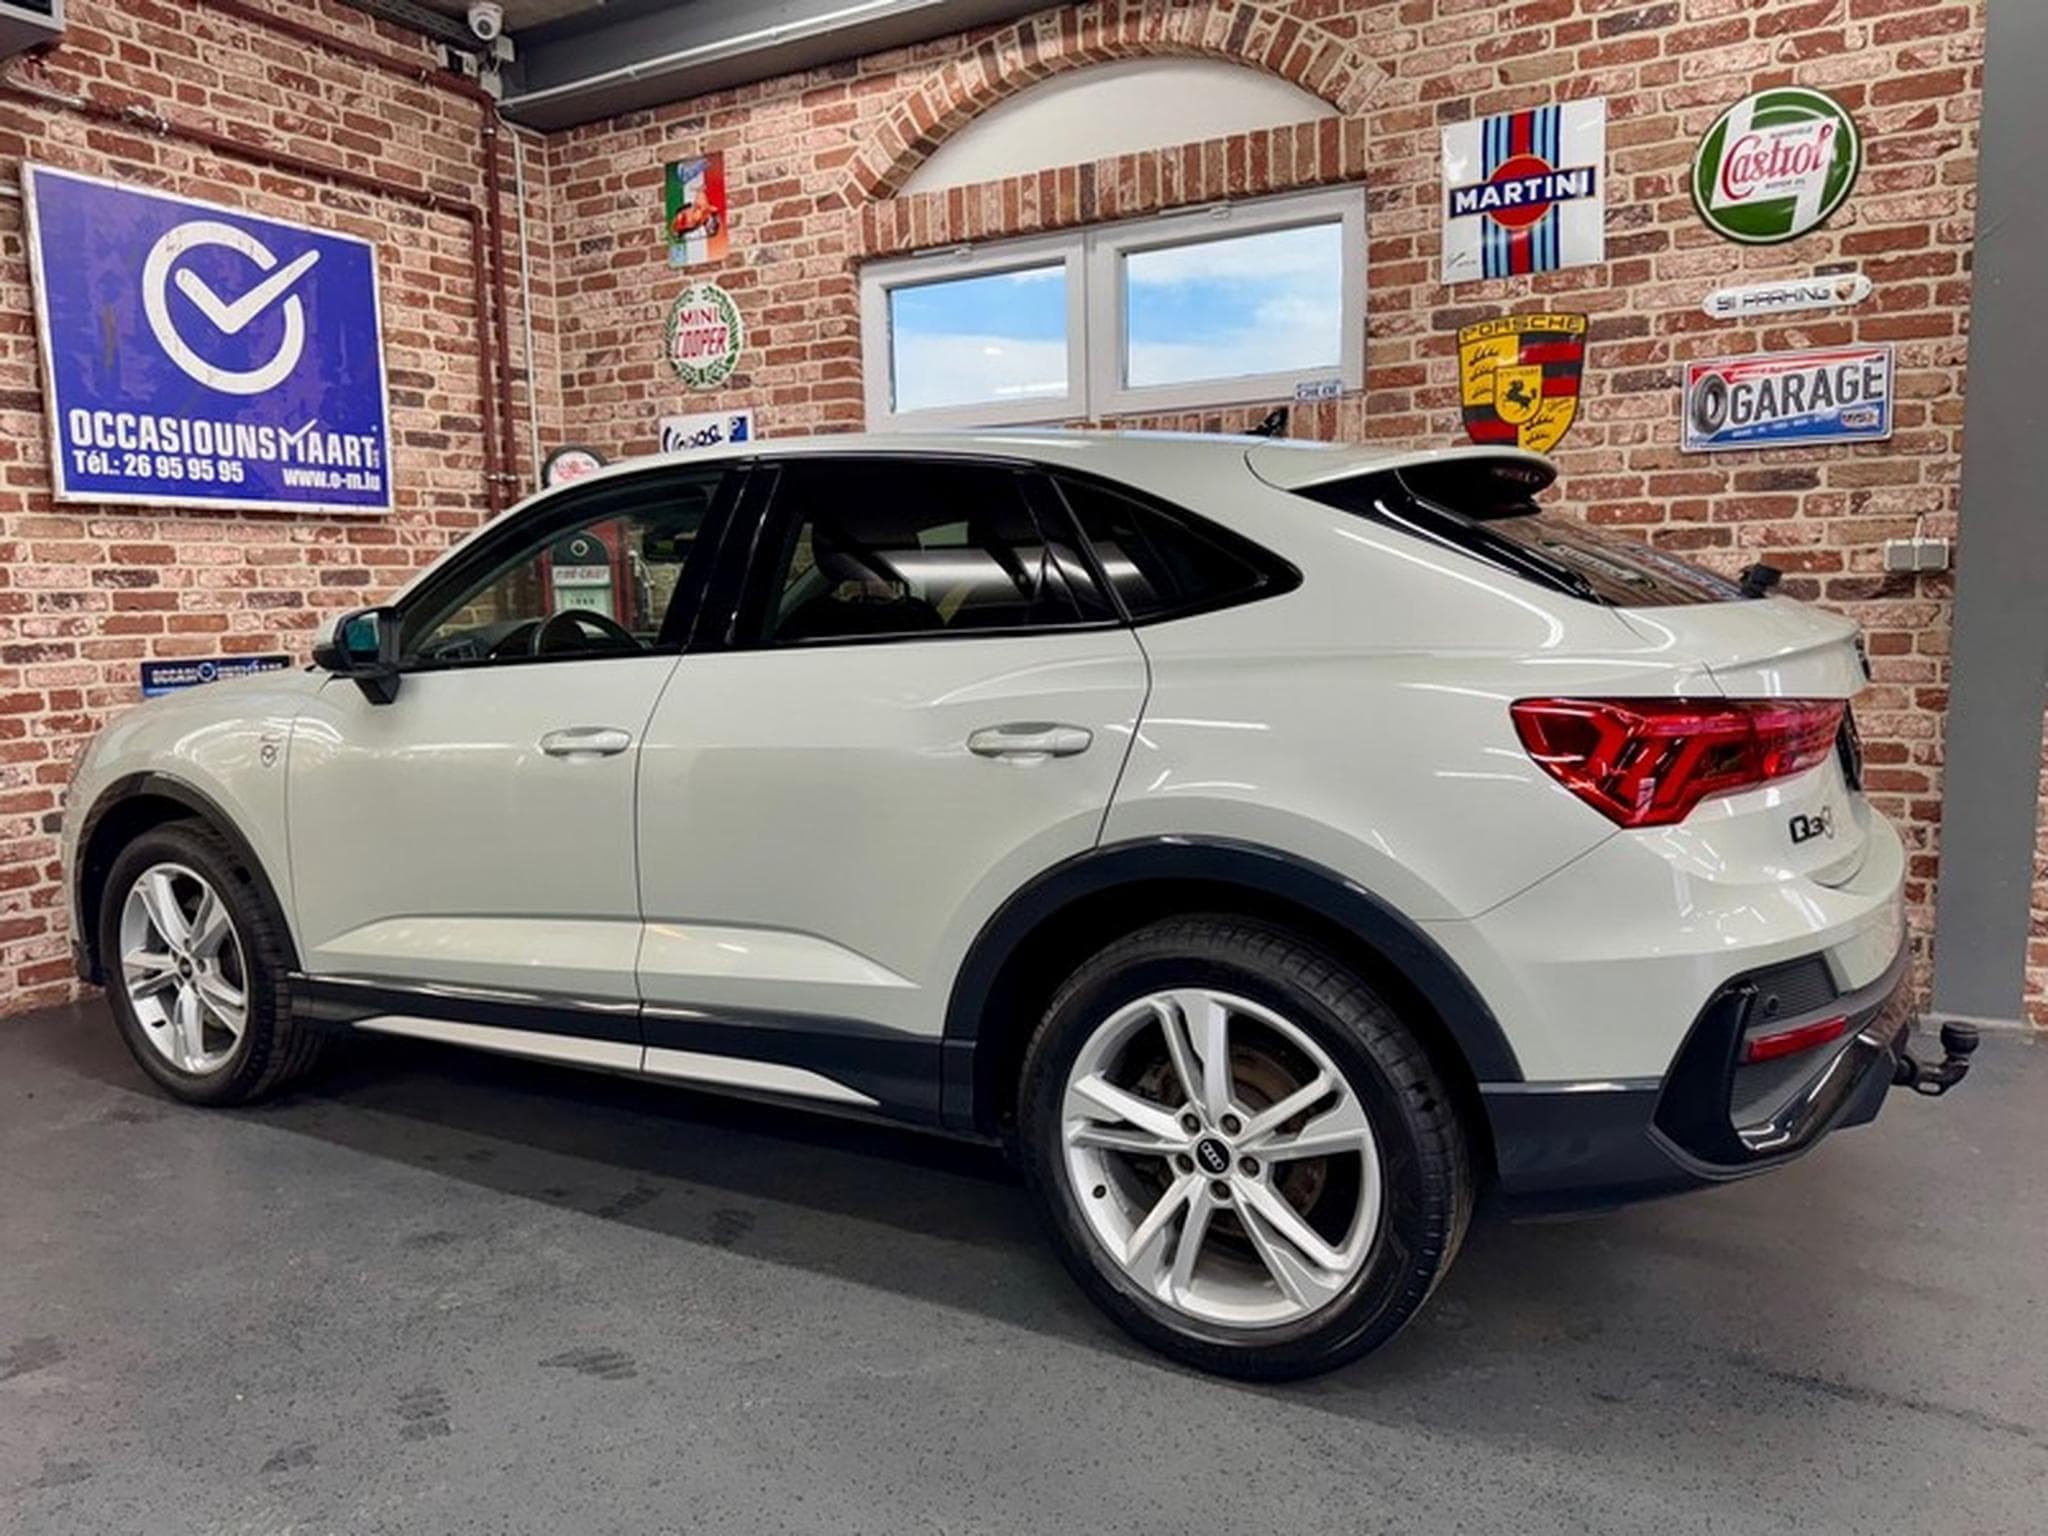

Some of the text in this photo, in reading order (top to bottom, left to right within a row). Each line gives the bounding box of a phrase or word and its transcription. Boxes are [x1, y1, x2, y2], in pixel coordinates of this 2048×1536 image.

[1721, 123, 1834, 200] Castrol
[1454, 171, 1589, 214] MARTINI
[680, 306, 718, 327] MINI
[1461, 317, 1580, 341] PORSCHE
[673, 326, 727, 359] COOPER
[1731, 356, 1884, 425] GARAGE
[124, 456, 150, 478] 26
[157, 457, 183, 479] 95
[188, 459, 215, 481] 95
[219, 460, 244, 483] 95
[283, 468, 380, 491] www.o-m.lu
[1789, 814, 1825, 844] Q3
